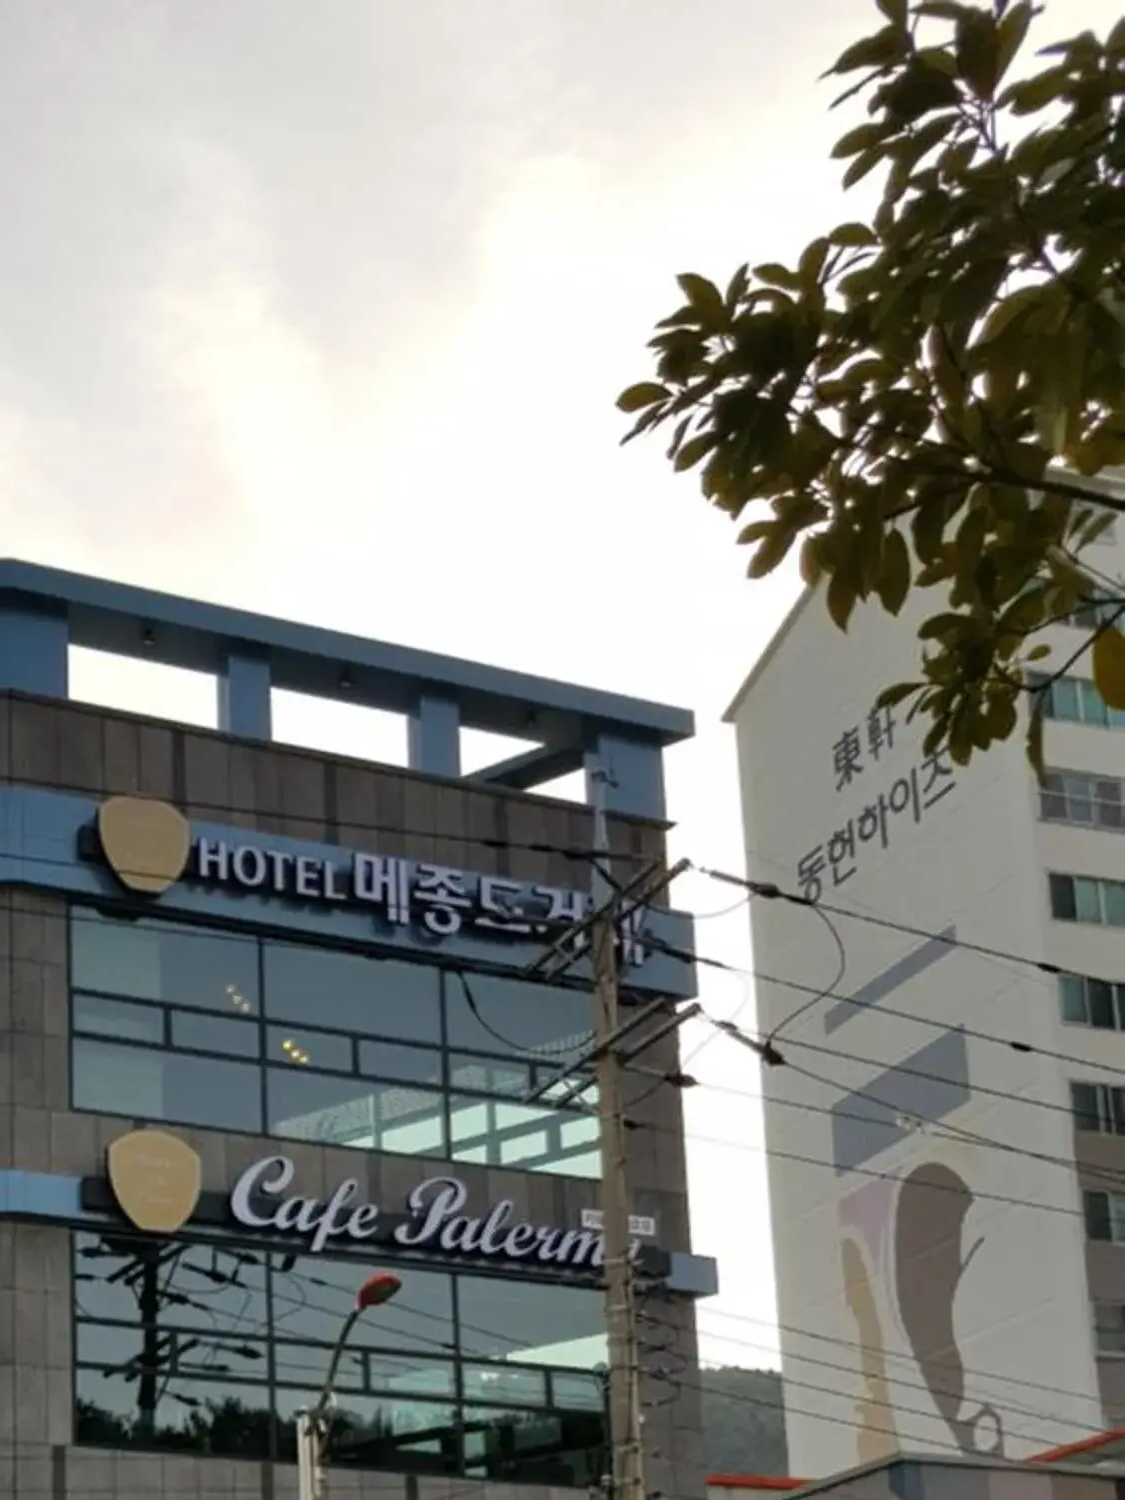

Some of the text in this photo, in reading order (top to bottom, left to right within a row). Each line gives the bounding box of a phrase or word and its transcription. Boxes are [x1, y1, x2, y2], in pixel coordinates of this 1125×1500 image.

[199, 836, 346, 901] HOTEL
[797, 747, 956, 905] 동현하이츠
[230, 1155, 378, 1253] Cafe
